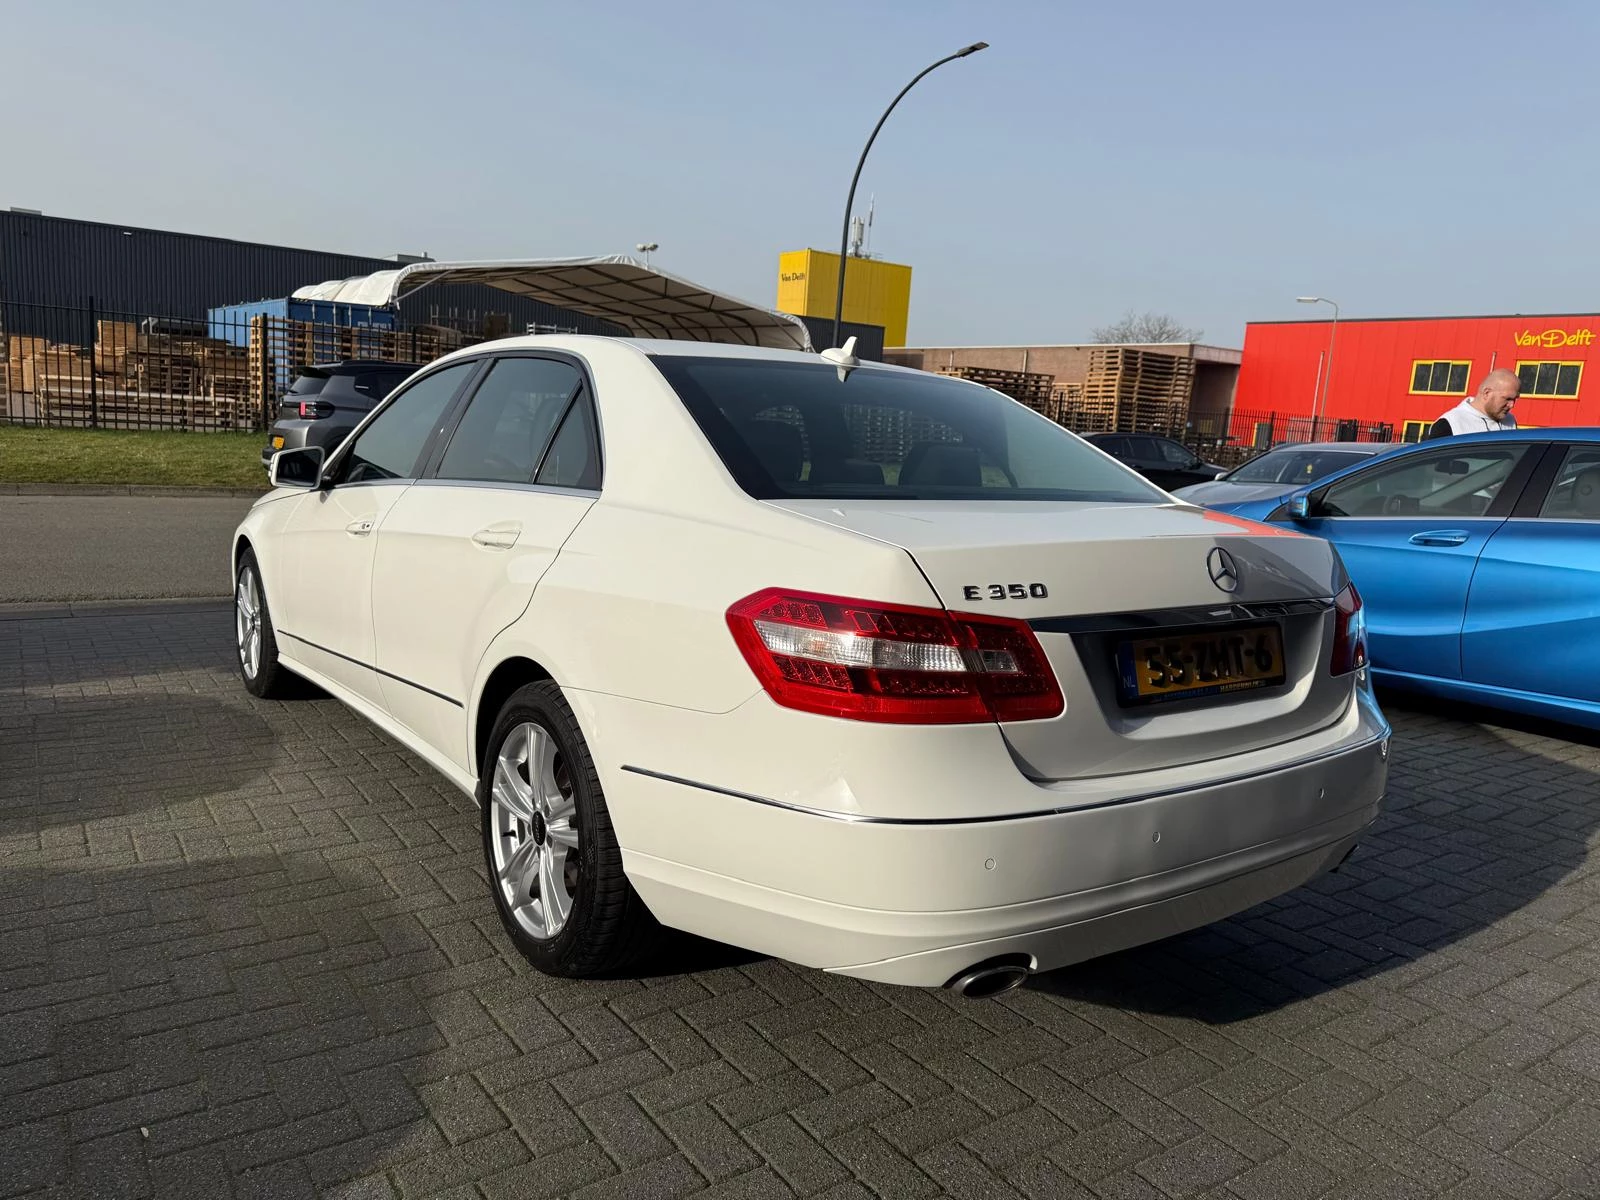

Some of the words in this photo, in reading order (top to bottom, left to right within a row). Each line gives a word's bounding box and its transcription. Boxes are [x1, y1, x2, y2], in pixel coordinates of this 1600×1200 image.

[1514, 330, 1541, 347] Van
[1541, 329, 1597, 348] Delft
[963, 585, 983, 601] E
[987, 583, 1049, 600] 350
[1123, 675, 1136, 689] NL
